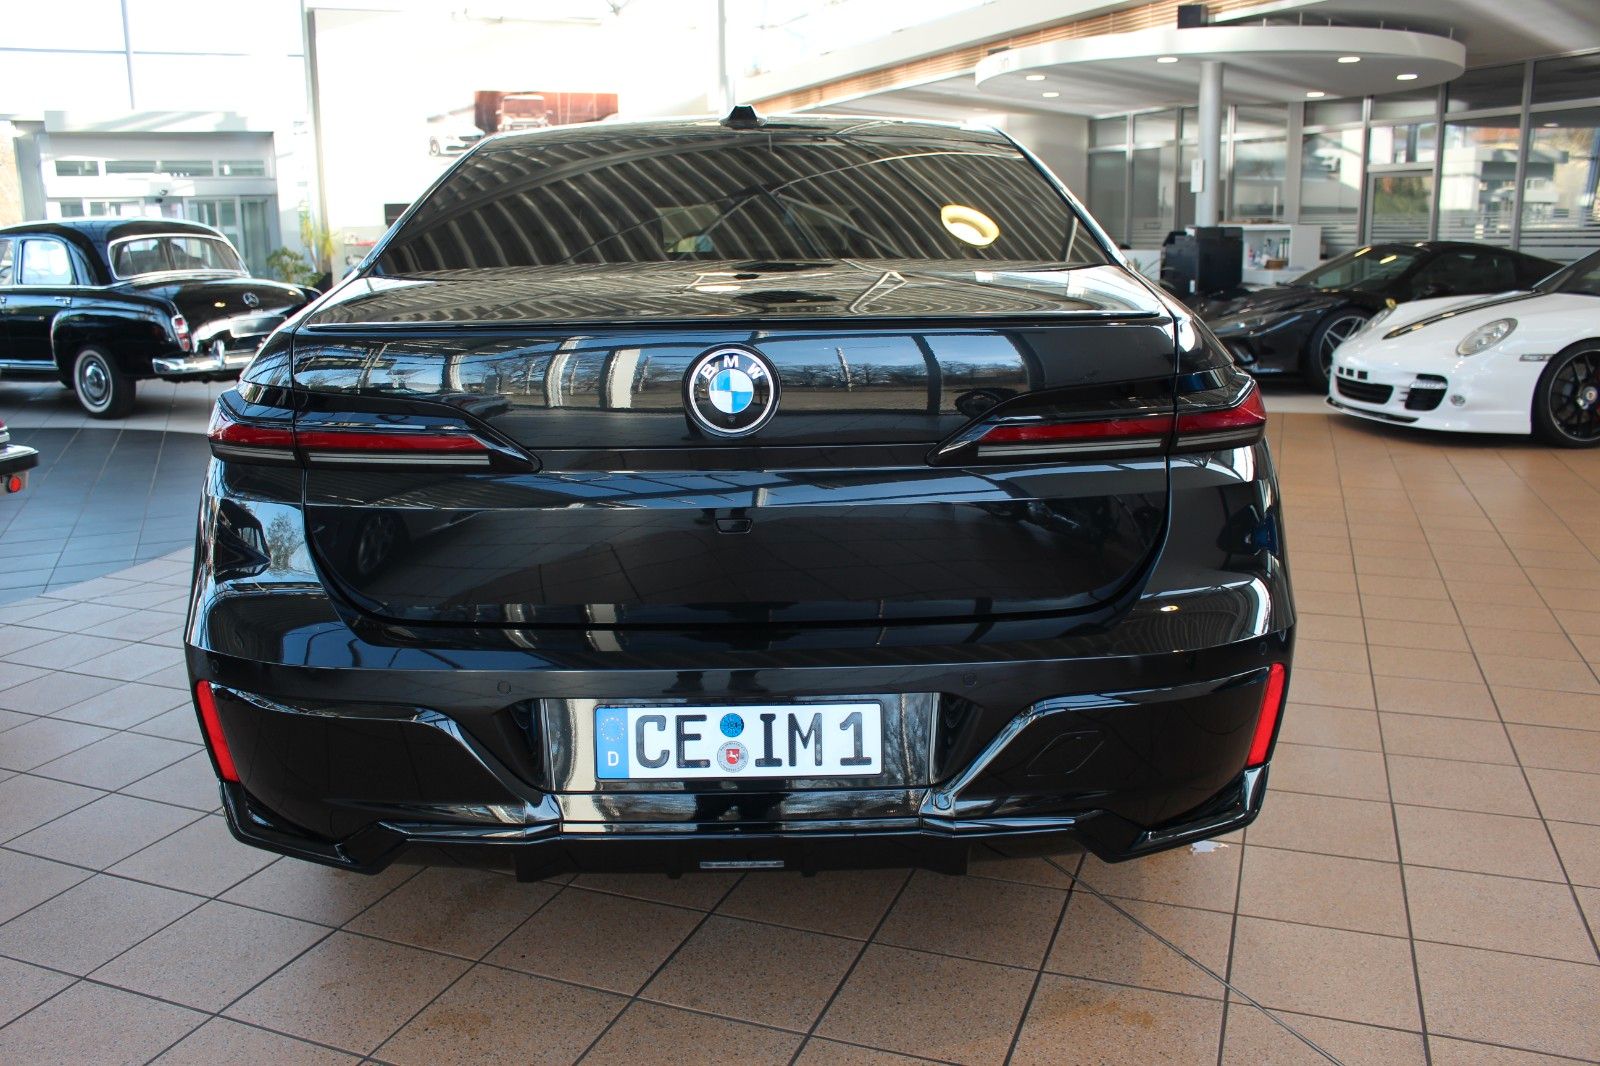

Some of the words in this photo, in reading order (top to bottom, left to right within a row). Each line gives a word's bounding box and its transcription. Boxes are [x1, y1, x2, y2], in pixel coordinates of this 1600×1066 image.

[700, 355, 764, 380] BMW
[635, 714, 711, 769] CE
[755, 712, 823, 767] IM
[840, 711, 872, 766] 1
[607, 751, 619, 767] D
